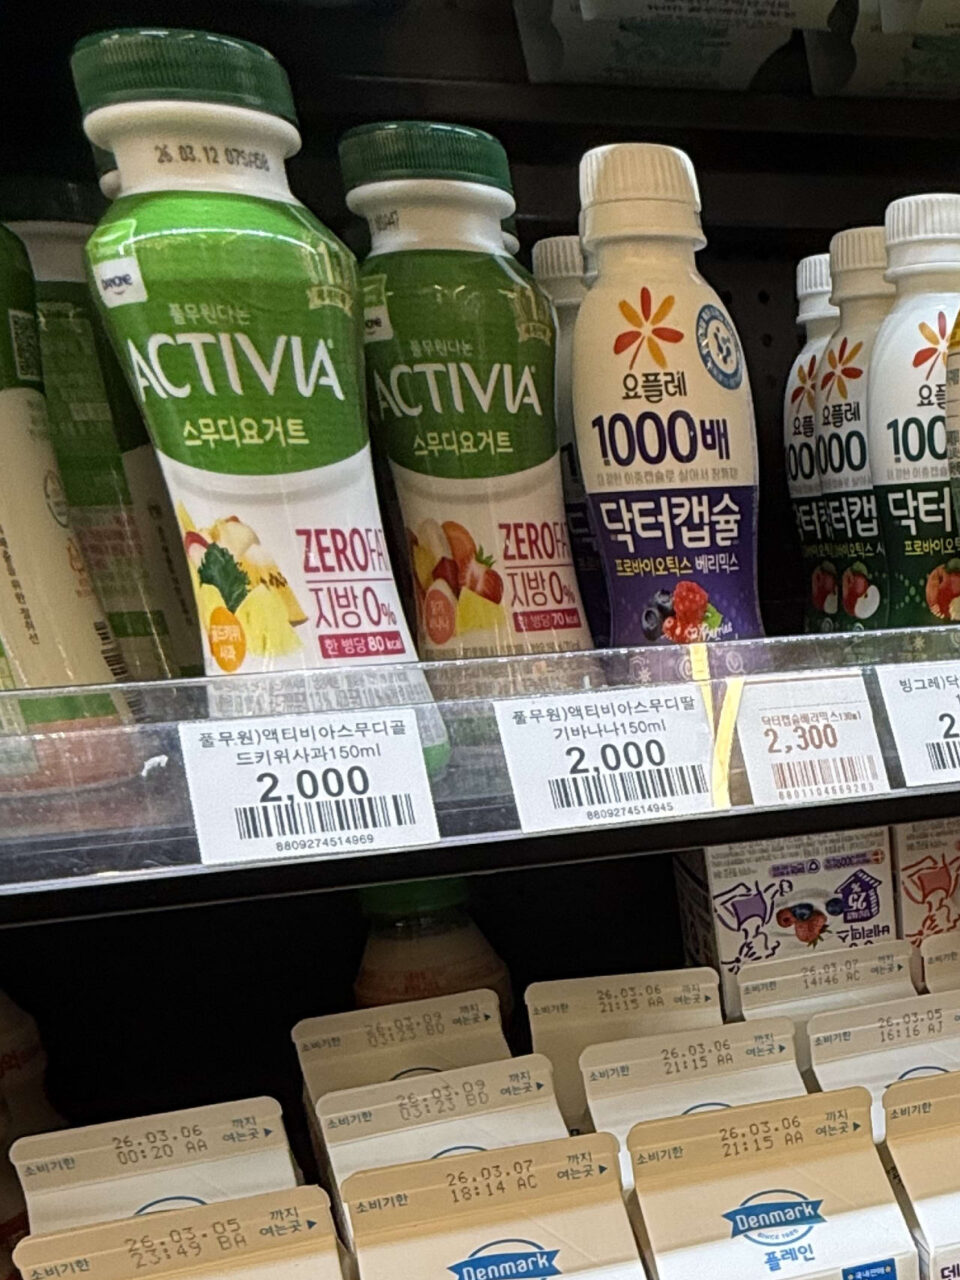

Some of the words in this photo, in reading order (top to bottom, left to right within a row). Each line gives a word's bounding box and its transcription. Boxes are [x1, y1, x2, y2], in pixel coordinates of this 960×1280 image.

[127, 332, 345, 402] ACTIVIA
[374, 362, 543, 419] ACTIVIA
[622, 372, 687, 402] 요플레
[183, 416, 309, 448] 스무디요거트
[414, 429, 513, 457] 스무디요거트
[599, 494, 741, 553] 닥터캡슐
[615, 556, 693, 577] 프로바이오틱스
[695, 555, 740, 574] 베리믹스
[552, 613, 566, 627] 70
[367, 636, 383, 652] 80
[512, 695, 695, 725] 풀무원)액티비아스무디딸
[198, 719, 407, 748] 풀무원)액티비아스무디골
[555, 718, 667, 742] 기바나나150ml
[764, 722, 838, 754] 2,300
[236, 742, 382, 766] 드키위사과150ml
[566, 738, 666, 777] 2,000
[257, 765, 369, 806] 2,000
[586, 801, 674, 821] 8809274514945
[276, 833, 375, 852] 8809274514969
[719, 1117, 801, 1142] 26.03.06
[446, 1159, 534, 1186] 26.03.07
[451, 1180, 506, 1204] 18:14
[735, 1203, 816, 1232] Denmark
[764, 1244, 816, 1272] 플레인
